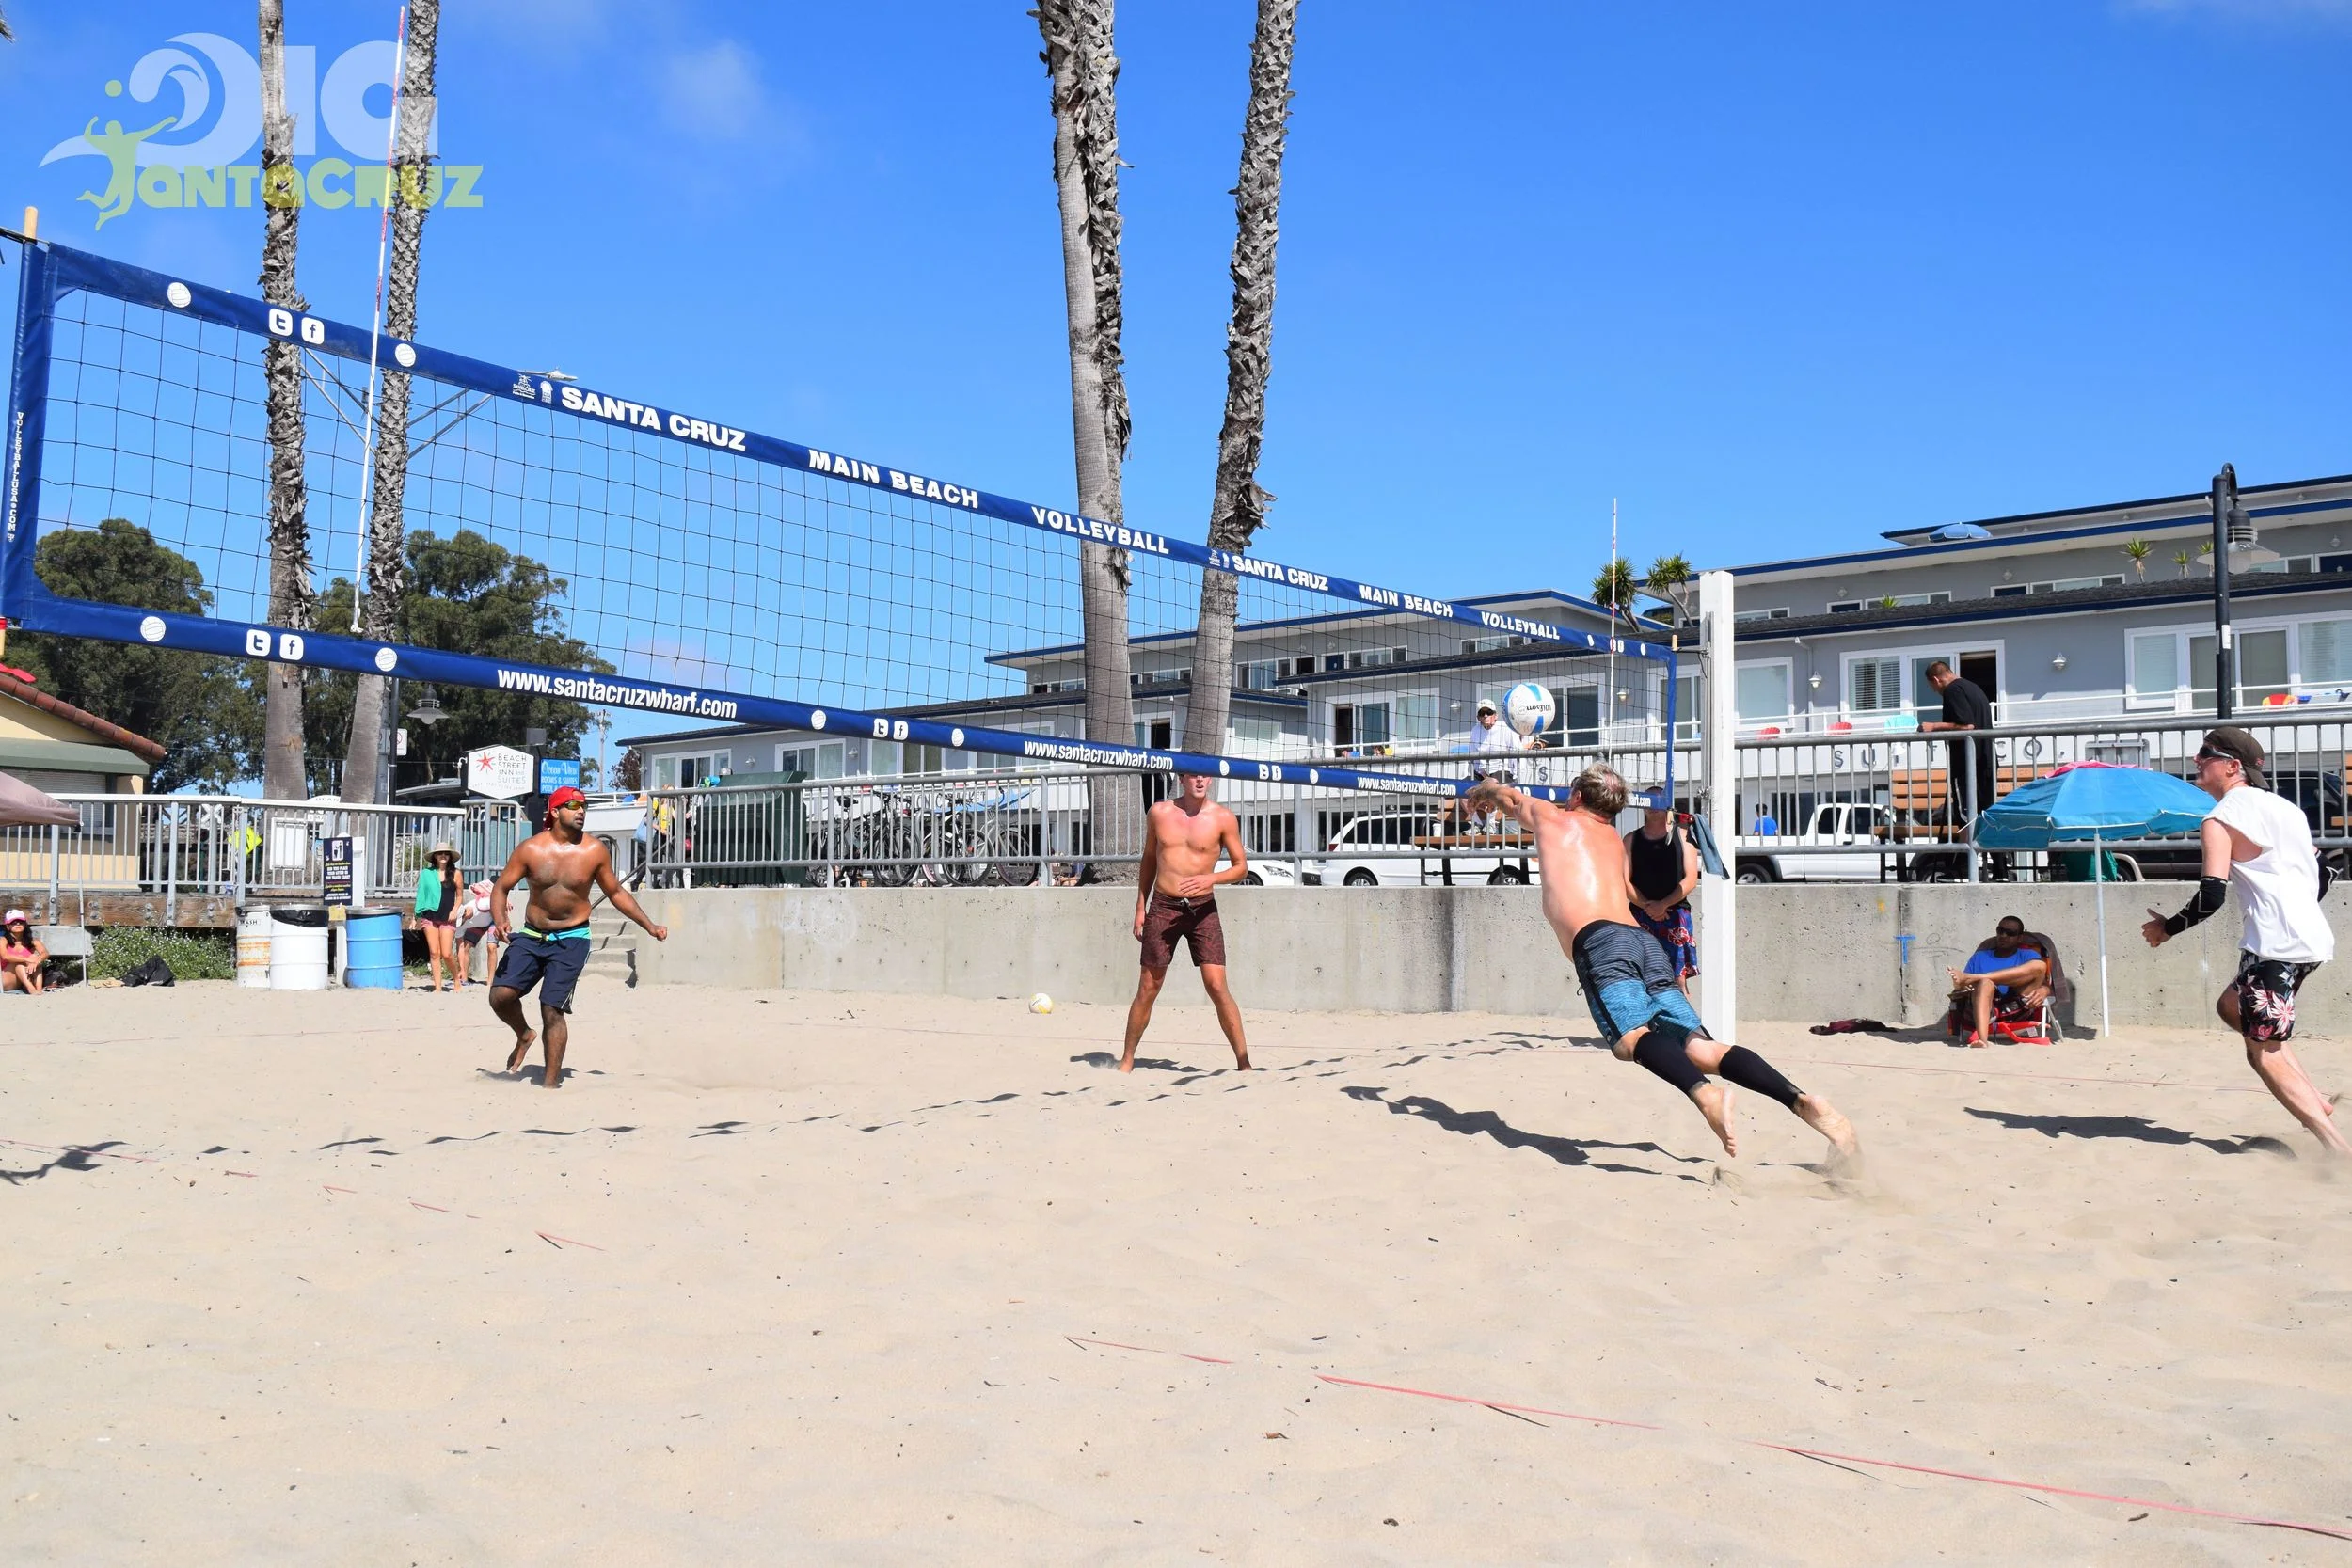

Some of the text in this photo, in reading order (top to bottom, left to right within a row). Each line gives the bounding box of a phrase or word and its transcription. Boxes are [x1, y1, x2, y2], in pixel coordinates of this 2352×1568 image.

[562, 387, 661, 431] SANTA
[669, 415, 746, 451] CRUZ
[809, 449, 880, 484] MAIN
[889, 470, 979, 509] BEACH
[1031, 506, 1169, 555] VOLLEYBALL
[1232, 553, 1285, 581] SANTA
[1287, 569, 1329, 592] CRUZ
[1359, 584, 1399, 607] MAIN
[1403, 594, 1454, 618] BEACH
[1481, 611, 1560, 641] VOLLEYBALL
[498, 669, 738, 719] www.santacruzwharf.com
[498, 753, 527, 762] BEACH
[1024, 740, 1174, 771] www.santacruzwharf.com
[497, 775, 527, 784] SUITES
[1357, 776, 1457, 796] www.santacruzwharf.com
